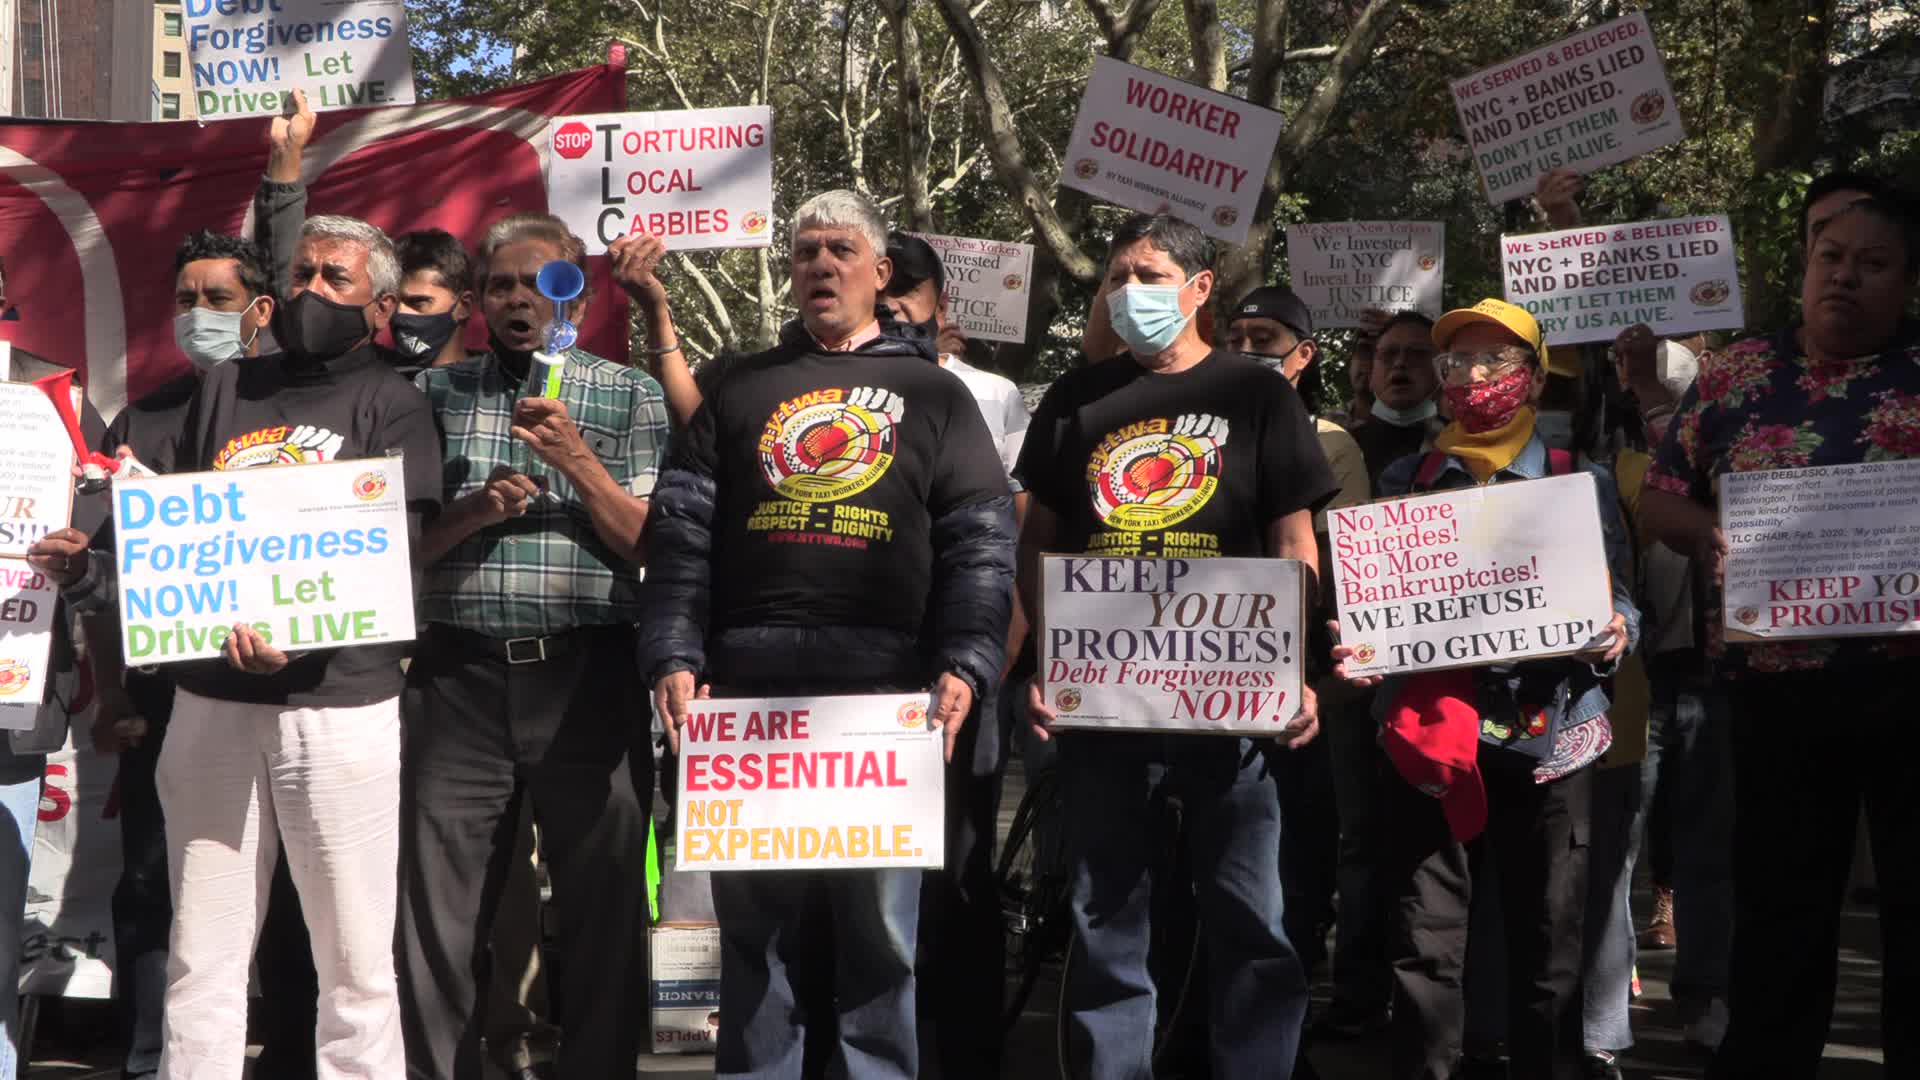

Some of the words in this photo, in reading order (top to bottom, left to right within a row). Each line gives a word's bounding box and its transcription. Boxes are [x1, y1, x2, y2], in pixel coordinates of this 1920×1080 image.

[190, 17, 392, 54] Forgiveness
[194, 57, 280, 87] NOW!
[304, 51, 353, 77] Let
[1456, 81, 1481, 99] WE
[1482, 57, 1542, 92] SERVED
[1547, 53, 1560, 67] &
[1562, 22, 1644, 61] BELIEVED.
[320, 81, 395, 107] LIVE.
[1464, 96, 1504, 126] NYC
[1510, 95, 1519, 106] +
[1524, 64, 1594, 104] BANKS
[1597, 45, 1645, 77] LIED
[1126, 78, 1241, 140] WORKER
[1472, 118, 1512, 148] AND
[1516, 80, 1623, 131] DECEIVED.
[556, 131, 591, 148] STOP
[596, 123, 764, 162] TORTURING
[1480, 138, 1532, 171] DON'T
[1534, 128, 1566, 156] LET
[1568, 108, 1619, 138] THEM
[1090, 121, 1248, 192] SOLIDARITY
[1487, 162, 1536, 192] BURY
[1538, 152, 1562, 173] US
[1567, 134, 1622, 168] ALIVE.
[601, 167, 703, 205] LOCAL
[597, 208, 729, 247] CABBIES
[1297, 224, 1316, 234] We
[1322, 224, 1351, 234] Serve
[1358, 223, 1385, 233] New
[1389, 223, 1432, 234] Yorkers
[1313, 236, 1341, 250] We
[1347, 235, 1412, 250] Invested
[1506, 241, 1534, 254] WE
[1539, 231, 1607, 252] SERVED
[1613, 230, 1627, 242] &
[1632, 220, 1724, 241] BELIEVED.
[943, 249, 1001, 270] Invested
[954, 238, 977, 250] New
[980, 242, 1022, 256] Yorkers
[1329, 254, 1345, 268] In
[1352, 253, 1393, 268] NYC
[1508, 257, 1552, 276] NYC
[1560, 257, 1572, 268] +
[1581, 245, 1659, 269] BANKS
[1668, 240, 1719, 259] LIED
[945, 265, 981, 284] NYC
[945, 281, 960, 296] In
[1304, 270, 1349, 287] Invest
[1355, 269, 1373, 284] In
[1511, 275, 1556, 295] AND
[1565, 262, 1687, 289] DECEIVED.
[948, 296, 997, 318] TICE.
[1334, 303, 1361, 319] Ou
[1577, 291, 1614, 311] LET
[1616, 286, 1676, 306] THEM
[956, 315, 1019, 337] Families
[1576, 314, 1602, 330] US
[1610, 307, 1673, 326] ALIVE.
[779, 483, 794, 496] NEW
[794, 488, 813, 498] YORK
[815, 490, 830, 498] TAXI
[832, 479, 865, 497] WORKERS
[865, 455, 890, 482] ALLIANCE
[1728, 473, 1768, 482] MAYOR
[1763, 482, 1793, 493] bigger
[118, 482, 246, 530] Debt
[754, 501, 812, 516] JUSTICE
[834, 505, 888, 526] RIGHTS
[1108, 514, 1122, 526] NEW
[1124, 518, 1141, 527] YORK
[1144, 518, 1160, 526] TAXI
[1161, 504, 1193, 524] WORKERS
[1193, 479, 1215, 506] ALLIANCE
[1335, 510, 1374, 534] No
[1383, 503, 1454, 528] More
[1729, 509, 1756, 518] some
[1758, 506, 1779, 515] kind
[747, 517, 808, 530] RESPECT
[832, 520, 894, 543] DIGNITY
[1088, 532, 1142, 548] JUSTICE
[1164, 532, 1218, 548] RIGHTS
[1337, 520, 1460, 559] Suicides!
[1731, 534, 1751, 544] TLC
[122, 527, 388, 576] Forgiveness
[1339, 558, 1378, 582] No
[1387, 551, 1459, 576] More
[1858, 562, 1884, 571] need
[0, 568, 50, 591] VED.
[1063, 558, 1190, 592] KEEP
[1344, 556, 1540, 606] Bankruptcies!
[1768, 576, 1861, 601] KEEP
[126, 580, 239, 620] NOW!
[271, 571, 336, 606] Let
[1148, 592, 1276, 628] YOUR
[1348, 606, 1404, 632] WE
[1412, 586, 1548, 625] REFUSE
[127, 620, 272, 658] Drives
[289, 610, 388, 645] LIVE.
[1049, 628, 1292, 664] PROMISES!
[1390, 640, 1436, 667] TO
[1445, 628, 1529, 660] GIVE
[1538, 619, 1597, 648] UP!
[1048, 660, 1109, 684] Debt
[1116, 661, 1276, 692] Forgiveness
[1170, 690, 1286, 722] NOW!
[687, 712, 736, 742] WE
[743, 710, 810, 741] ARE
[686, 750, 908, 792] ESSENTIAL
[687, 799, 744, 826] NOT
[684, 824, 922, 862] EXPENDABLE.
